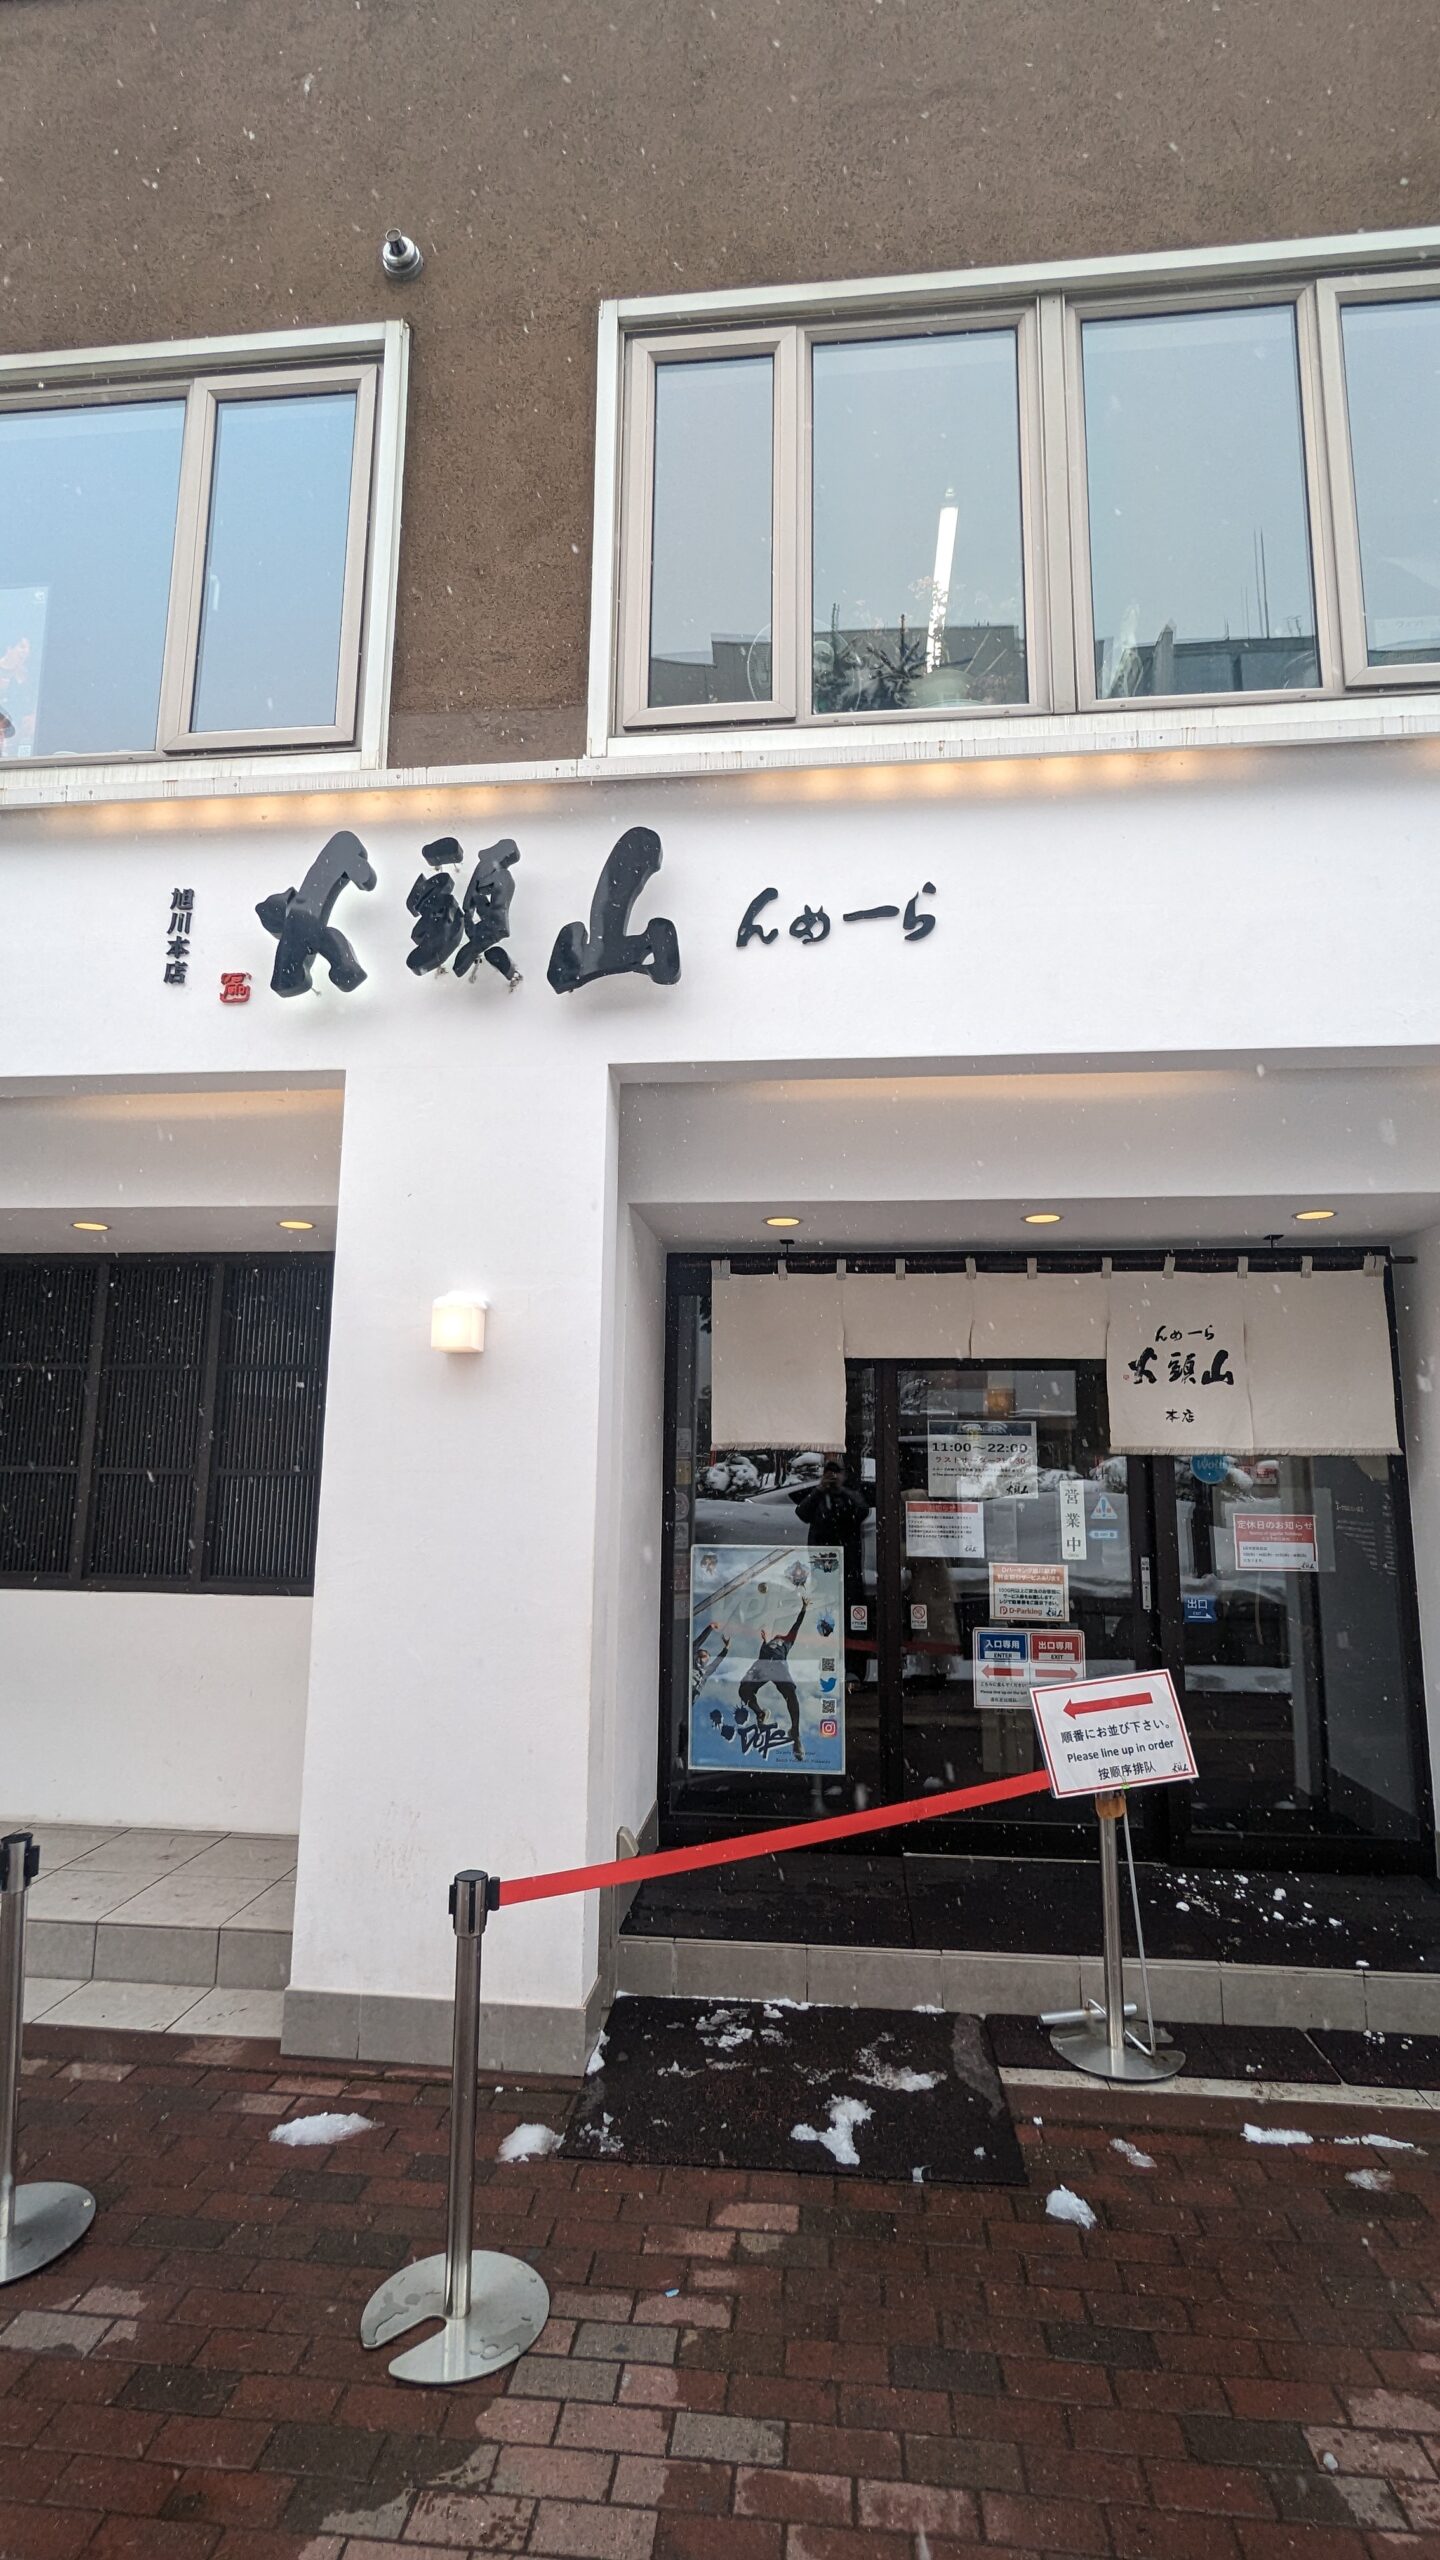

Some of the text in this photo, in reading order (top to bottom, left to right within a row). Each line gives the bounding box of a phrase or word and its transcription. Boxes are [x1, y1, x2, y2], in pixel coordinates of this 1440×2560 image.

[163, 887, 195, 985] 旭川本店
[1165, 1409, 1195, 1423] 本店
[1064, 1488, 1082, 1553] 営業中
[1236, 1520, 1313, 1530] 定休日のお知らせ
[1009, 1607, 1042, 1615] D-Parking
[1187, 1599, 1208, 1609] 出口
[985, 1640, 1020, 1649] 入口専用
[1038, 1641, 1073, 1650] 出口専用
[1060, 1719, 1170, 1744] 順番にお並び下さい。
[1067, 1739, 1175, 1763] Please line up in order
[1098, 1761, 1157, 1780] 按顺序排队
